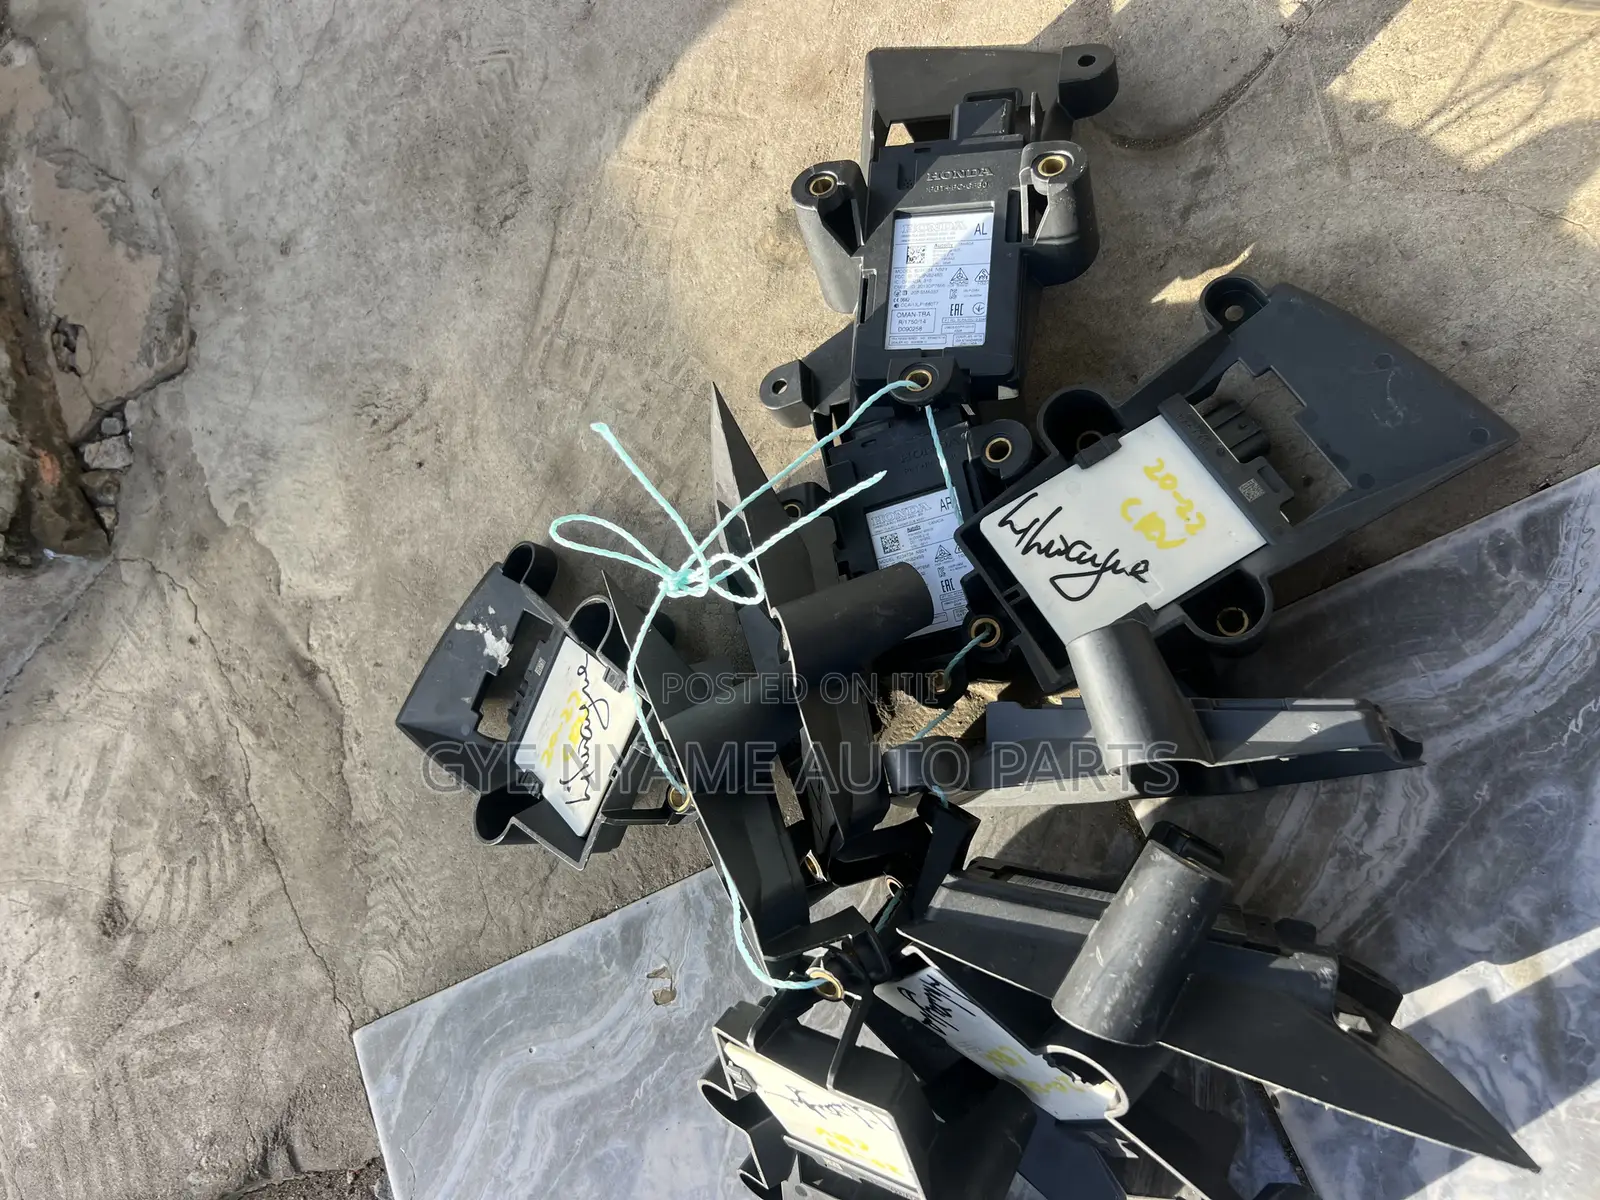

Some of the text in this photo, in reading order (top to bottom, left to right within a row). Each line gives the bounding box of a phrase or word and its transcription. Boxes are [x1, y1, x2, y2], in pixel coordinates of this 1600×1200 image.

[926, 167, 994, 182] HONDA
[973, 222, 988, 236] AL
[950, 303, 964, 317] EAC
[870, 501, 932, 525] HONDA
[940, 578, 956, 593] EAC
